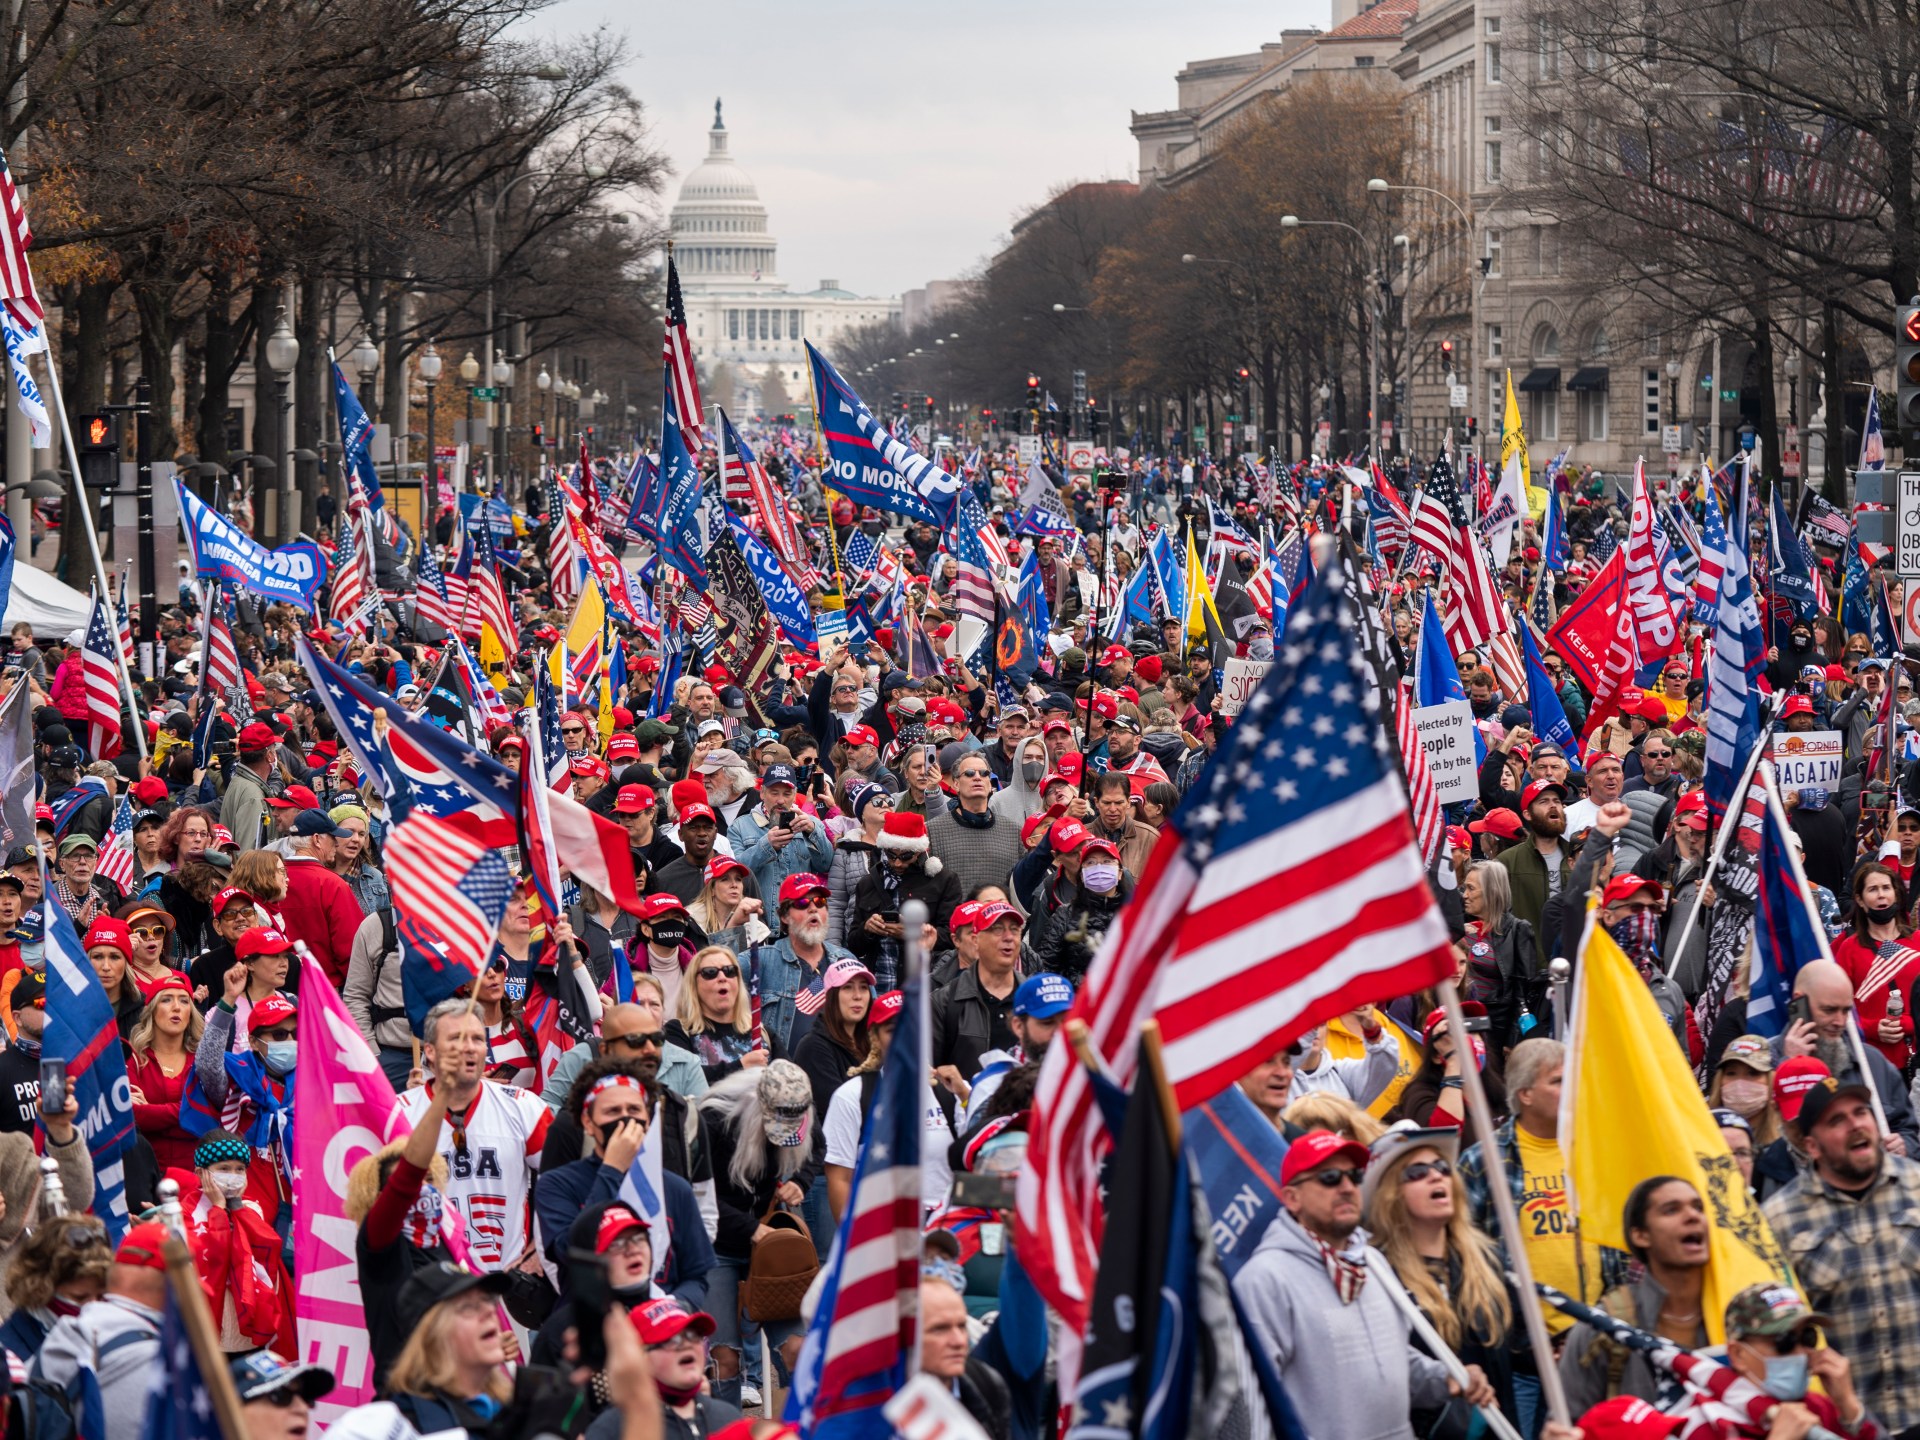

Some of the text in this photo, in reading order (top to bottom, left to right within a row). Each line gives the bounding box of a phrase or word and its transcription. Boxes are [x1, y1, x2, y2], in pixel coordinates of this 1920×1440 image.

[832, 459, 856, 479] NO
[1904, 481, 1920, 495] TH
[1903, 534, 1920, 549] OB
[730, 522, 809, 620] TRUMP
[264, 577, 304, 597] GREA
[1226, 579, 1248, 594] LIBE
[1777, 574, 1803, 585] EEP
[1692, 603, 1719, 621] EPIN
[776, 611, 805, 633] GREA
[1567, 628, 1595, 660] KEEP
[1244, 665, 1264, 676] NO
[1417, 715, 1463, 731] elected by
[1778, 741, 1839, 753] CALIFORNIA
[1443, 758, 1454, 770] by
[1456, 756, 1471, 767] the
[1435, 776, 1461, 792] press!
[137, 808, 154, 817] USA
[222, 888, 240, 899] USA
[653, 898, 679, 906] TRUMP
[1036, 984, 1071, 997] AMERICA
[1522, 1169, 1567, 1190] Tru
